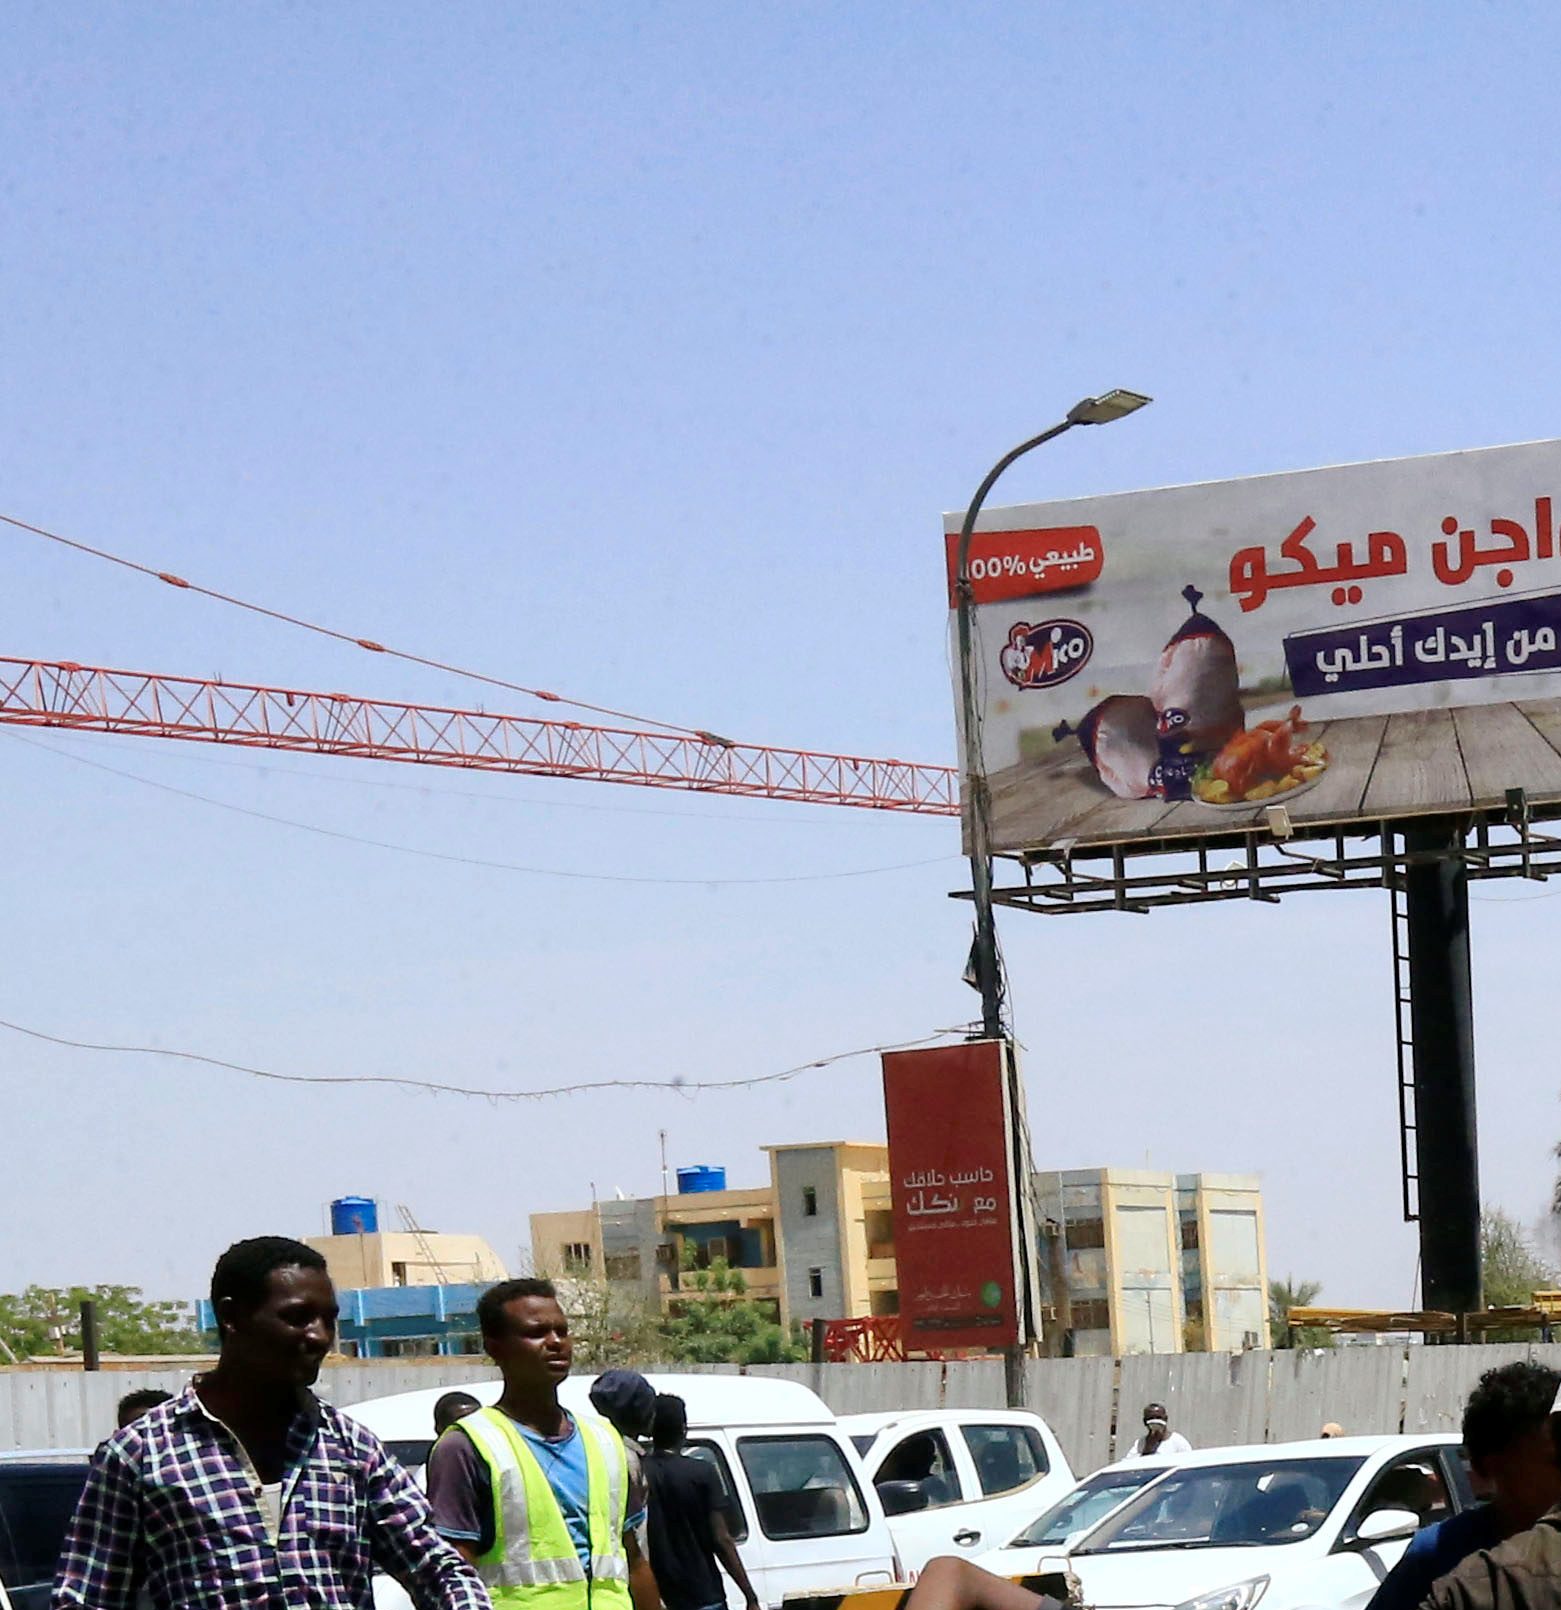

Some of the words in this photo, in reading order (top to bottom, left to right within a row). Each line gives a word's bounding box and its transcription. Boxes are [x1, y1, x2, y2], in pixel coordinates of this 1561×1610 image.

[967, 554, 1026, 580] 00%
[1029, 542, 1095, 579] طبيعي
[1229, 515, 1408, 612] ميكو
[1316, 625, 1403, 682] أحلي
[1414, 621, 1496, 669] إيدك
[1506, 626, 1557, 665] من
[948, 1166, 994, 1188] حاسب
[973, 1196, 997, 1215] مع
